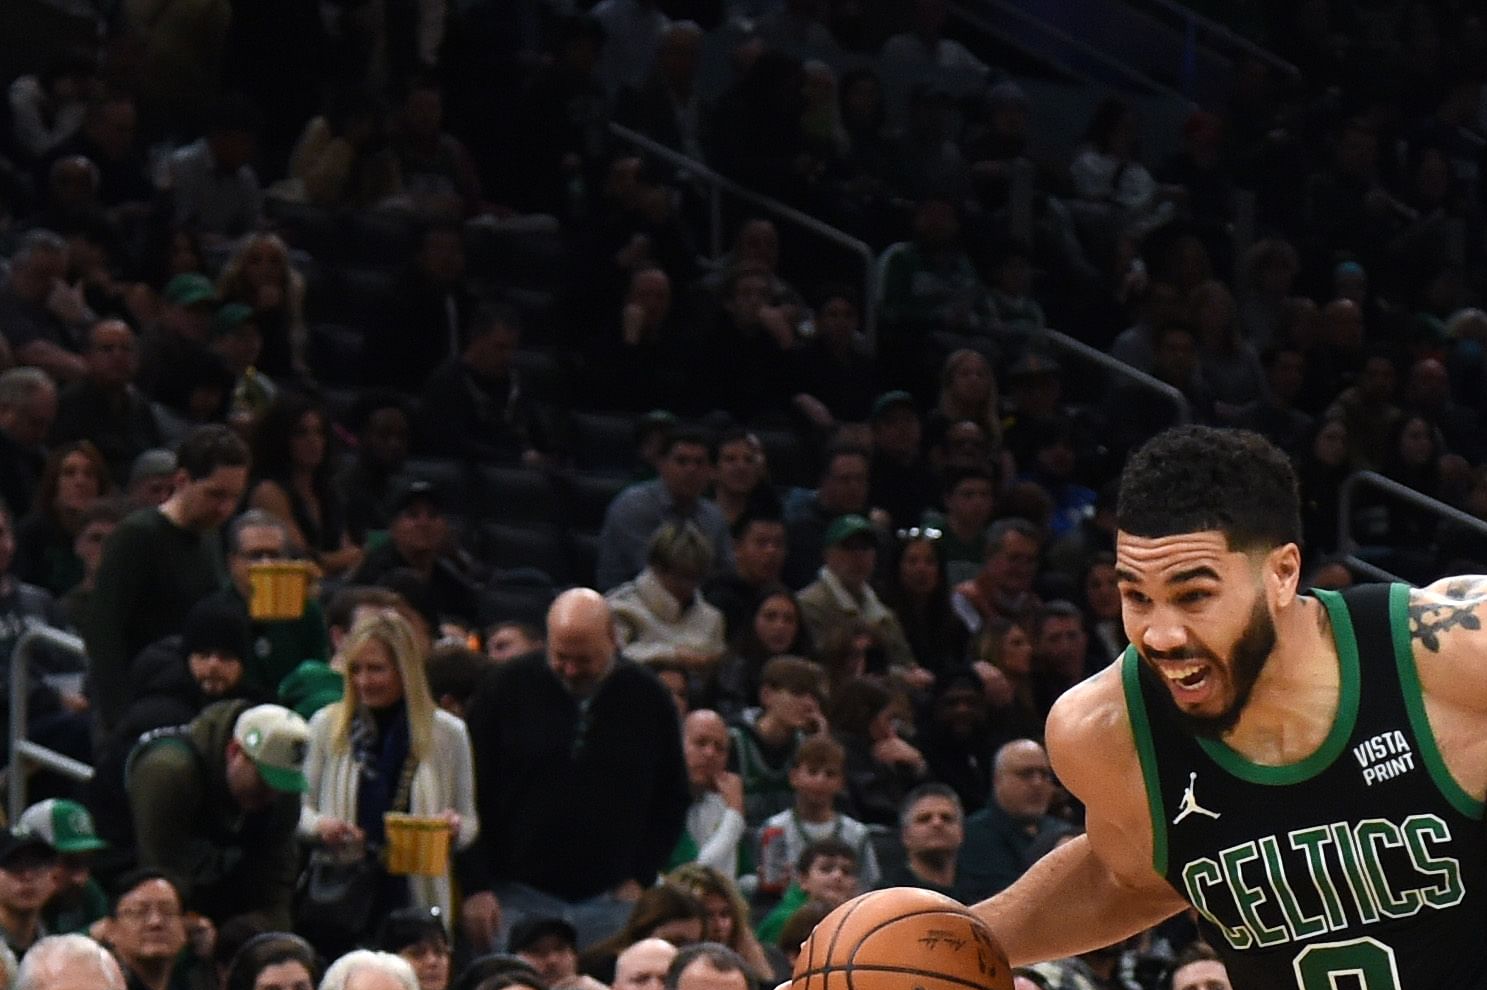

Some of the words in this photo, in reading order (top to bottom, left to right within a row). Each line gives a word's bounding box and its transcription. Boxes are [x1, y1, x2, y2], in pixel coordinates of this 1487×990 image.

[1353, 730, 1411, 768] VISTA
[1362, 752, 1415, 786] PRINT
[1182, 813, 1466, 950] CELTICS
